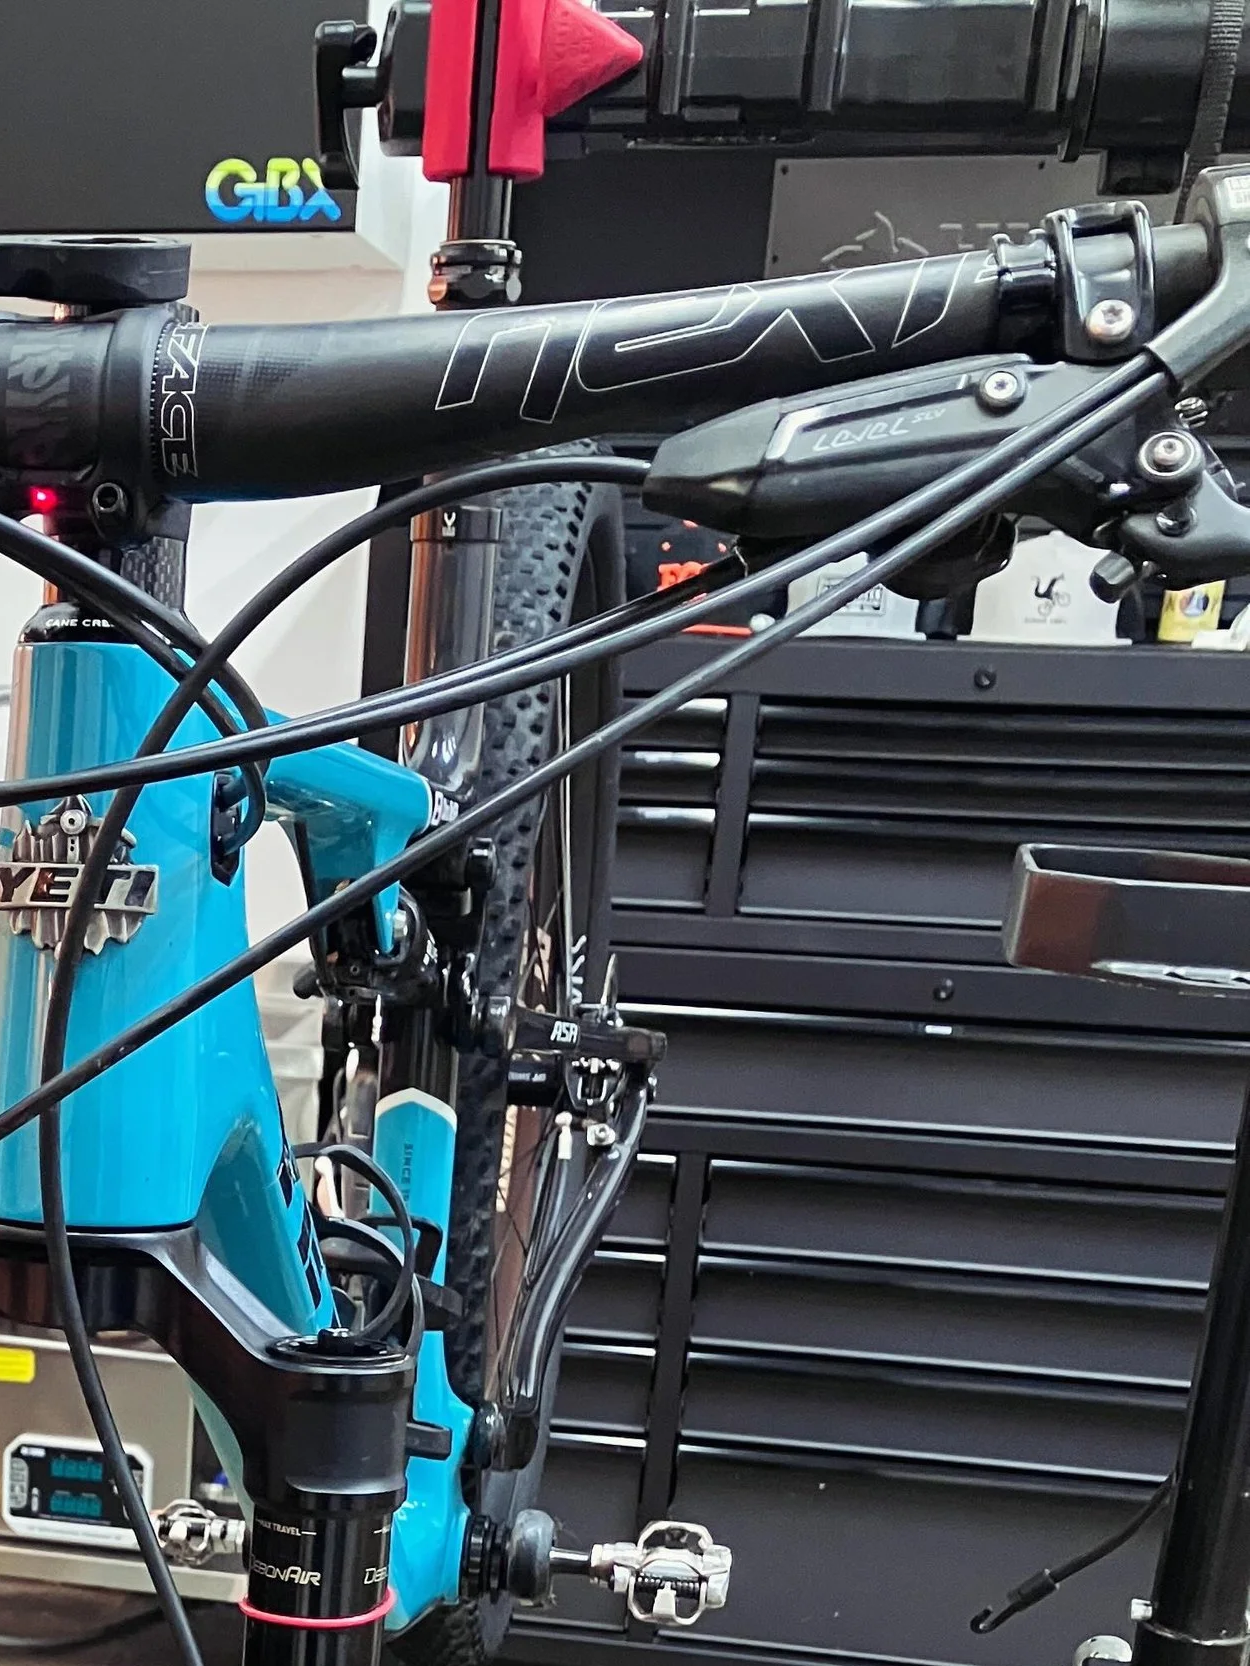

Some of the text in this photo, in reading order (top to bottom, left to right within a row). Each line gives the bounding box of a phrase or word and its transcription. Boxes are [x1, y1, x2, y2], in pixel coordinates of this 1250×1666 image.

[206, 157, 342, 223] GBX
[45, 618, 79, 628] CANE
[273, 1523, 302, 1537] TRAVEL
